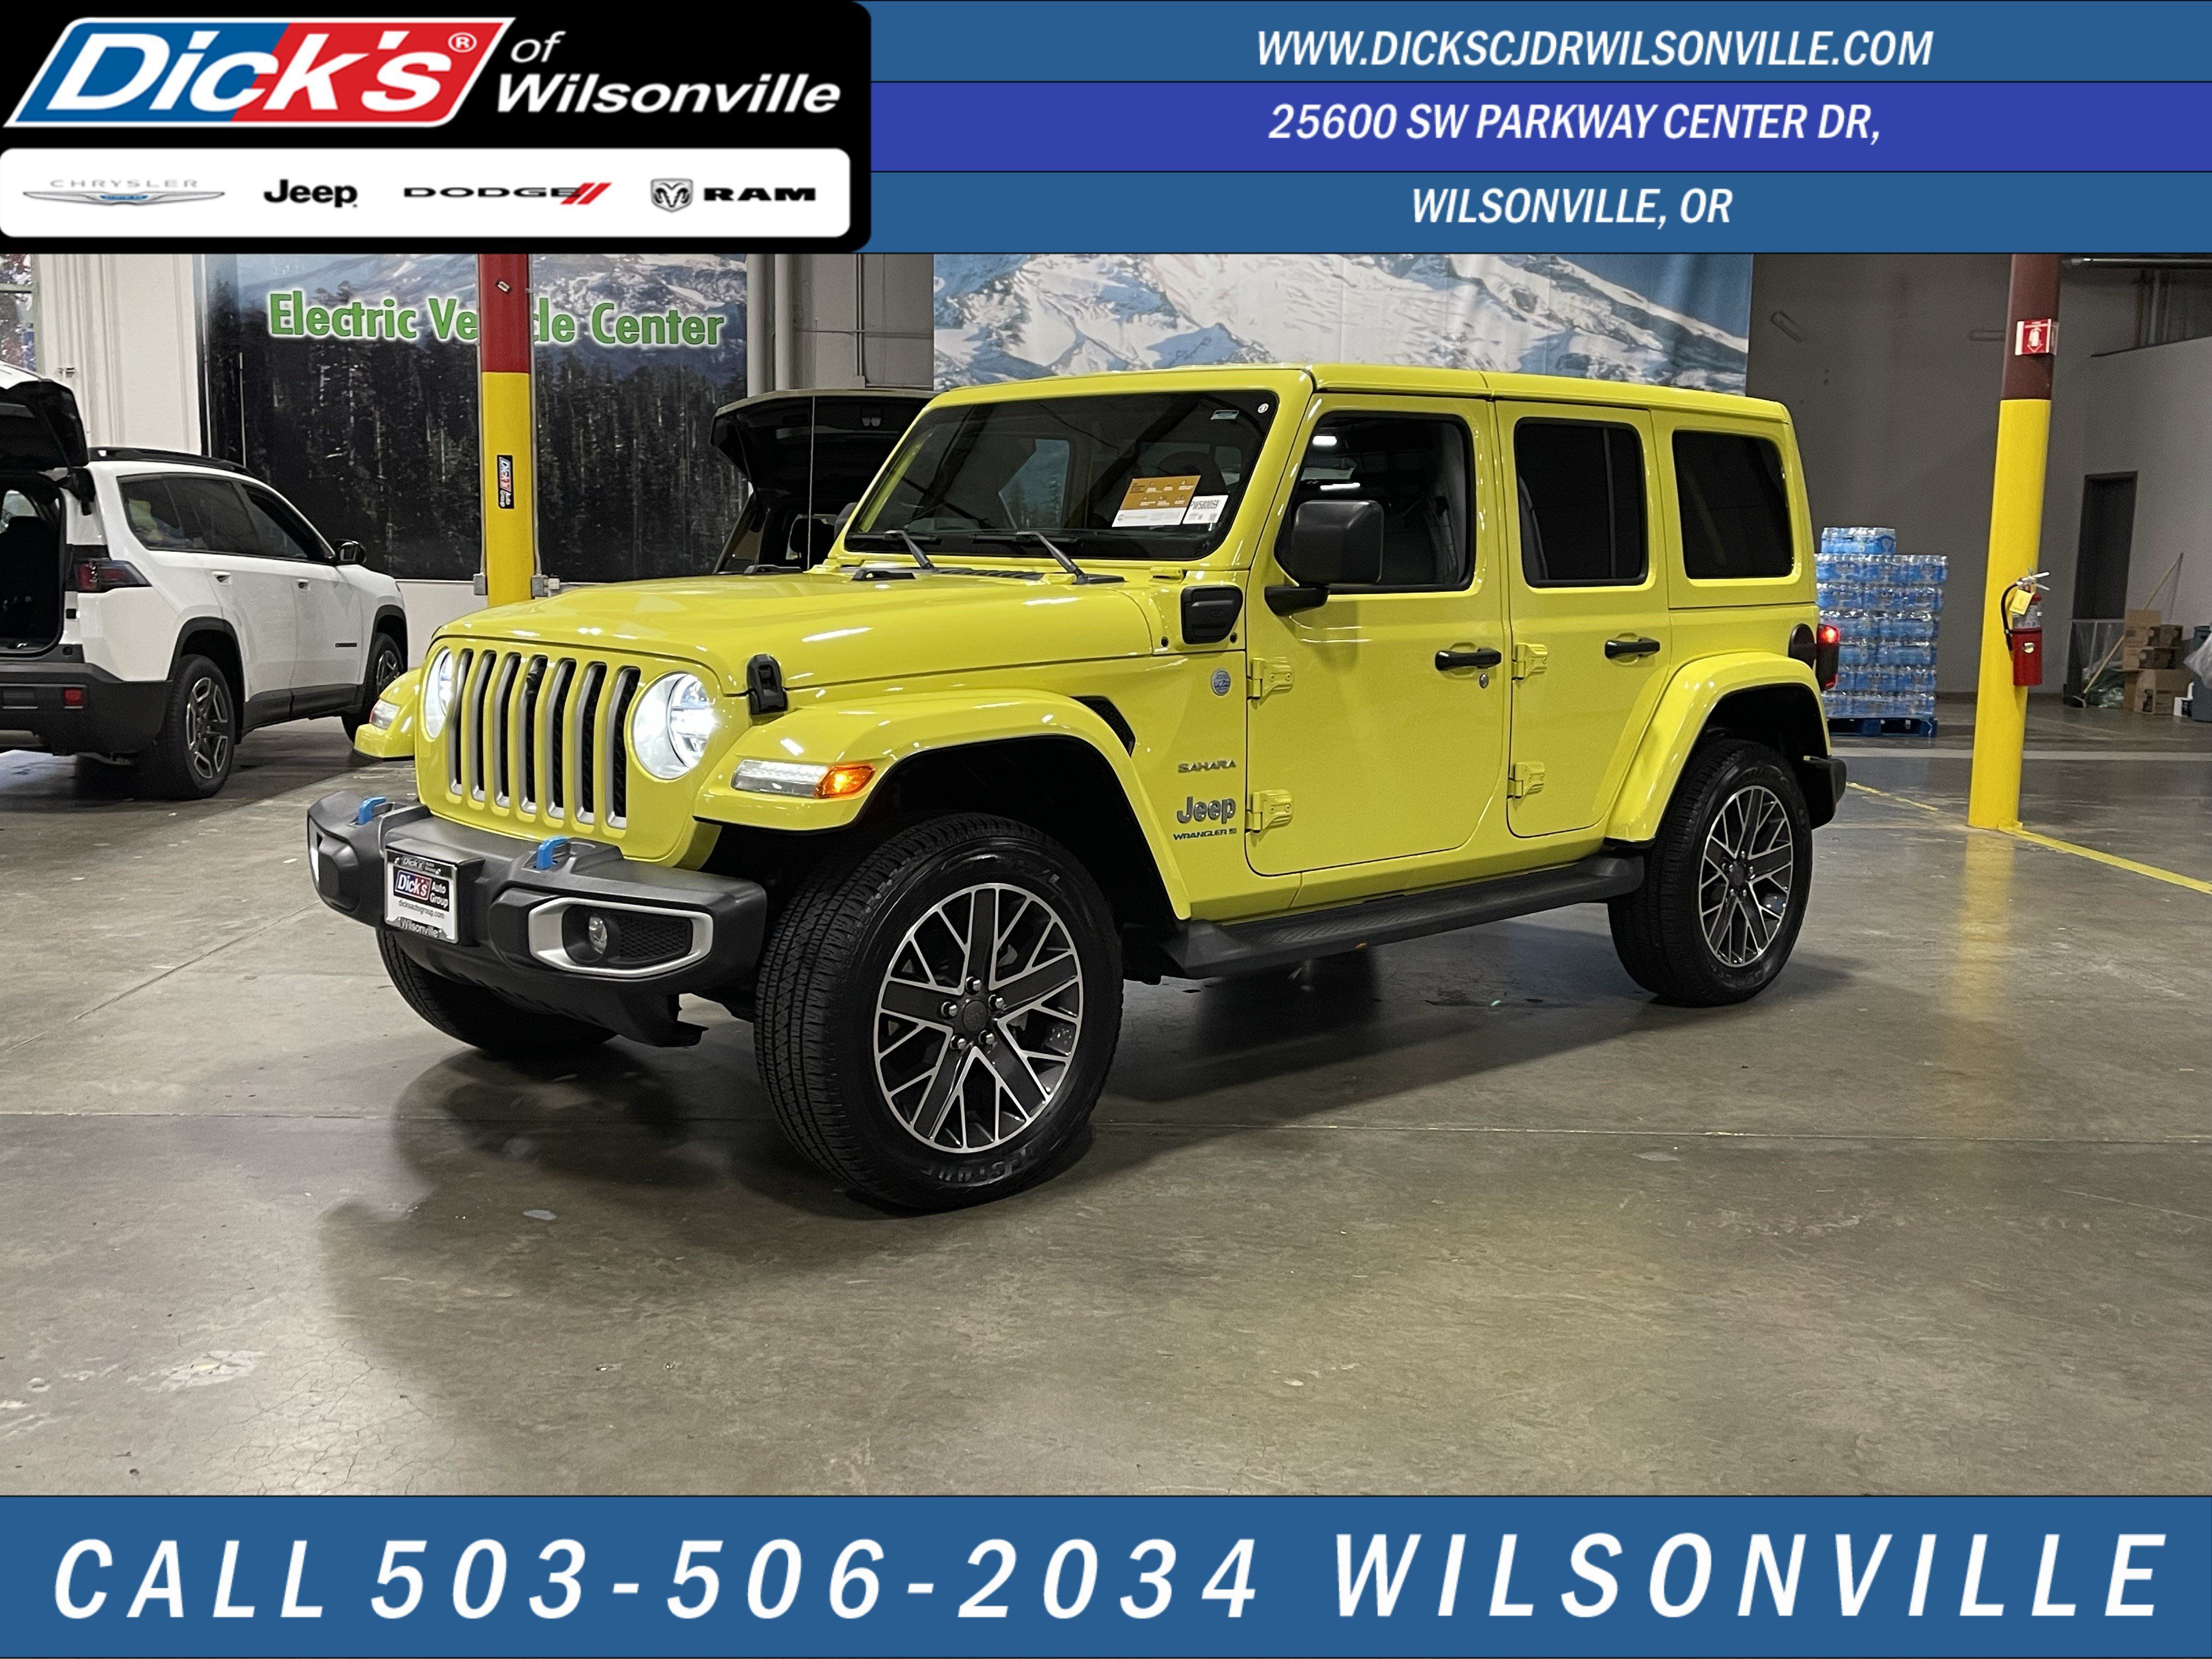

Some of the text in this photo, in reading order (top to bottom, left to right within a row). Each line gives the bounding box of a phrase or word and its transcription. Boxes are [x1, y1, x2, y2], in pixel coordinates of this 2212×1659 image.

[270, 290, 724, 345] Electric Vele Center
[1177, 759, 1237, 774] SAHARA
[1176, 795, 1236, 825] Jeep
[1173, 828, 1227, 840] WRANGLER
[397, 874, 428, 896] Dick's
[431, 881, 447, 894] Auto
[430, 893, 449, 909] Group
